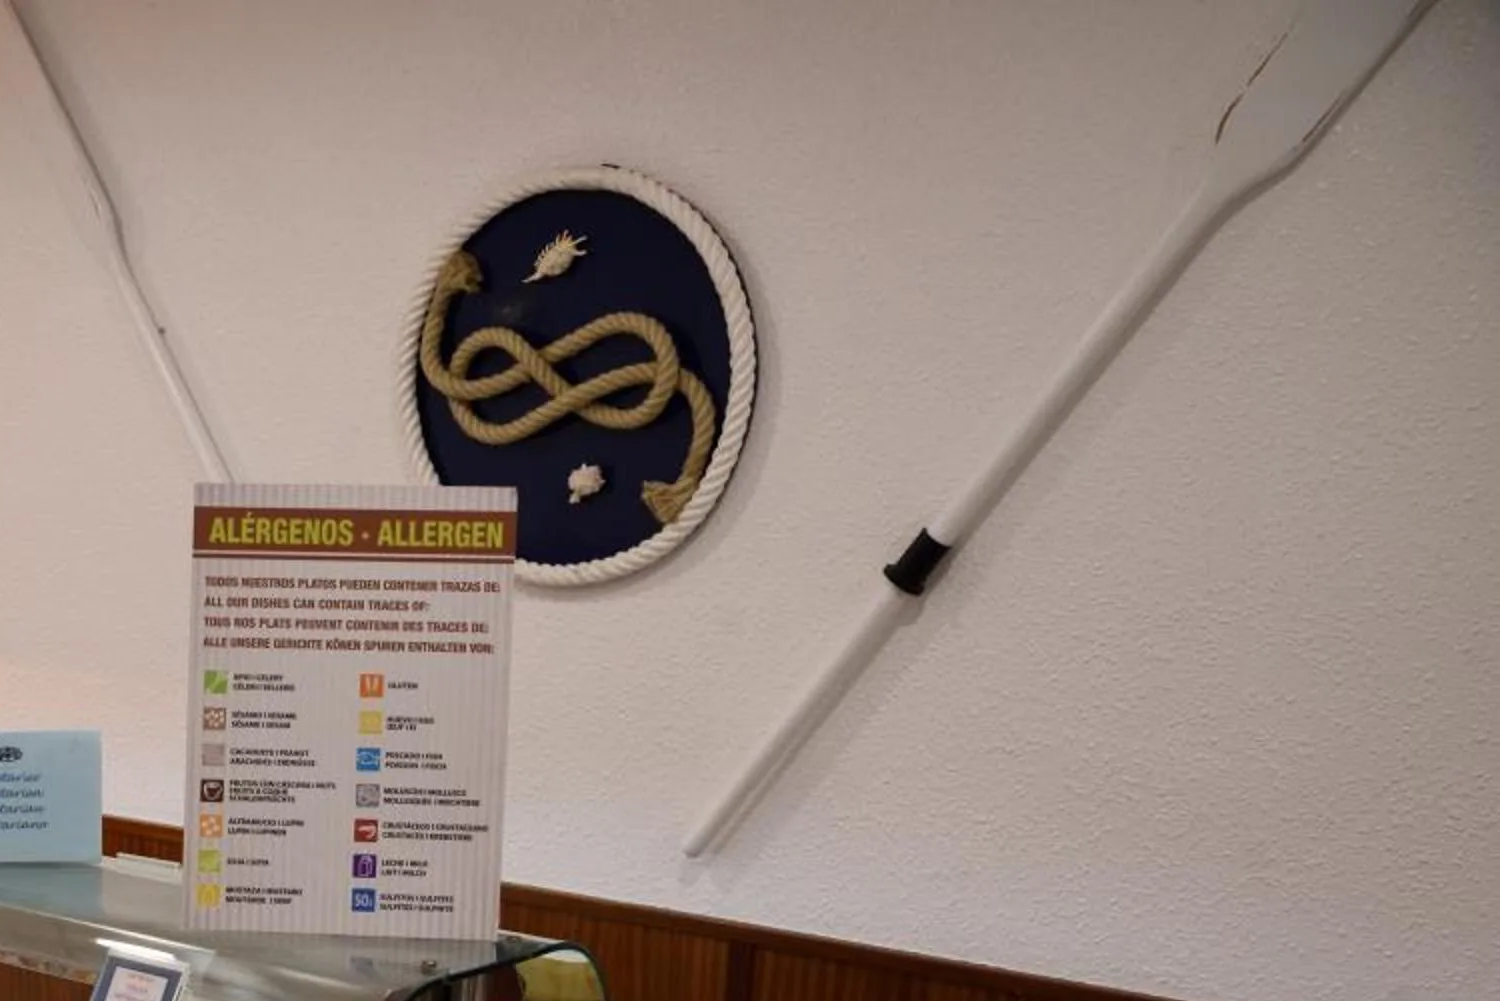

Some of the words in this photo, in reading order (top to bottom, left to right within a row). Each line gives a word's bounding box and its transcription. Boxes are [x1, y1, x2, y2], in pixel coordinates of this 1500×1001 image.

[208, 511, 354, 547] ALÉRGENOS
[377, 520, 504, 548] ALLERGEN
[204, 576, 239, 588] TODOS
[241, 577, 295, 589] NUESTROS
[297, 578, 337, 590] PLATOS
[339, 579, 381, 590] PUEDEN
[441, 581, 481, 593] TRAZAS
[203, 596, 222, 607] ALL
[226, 597, 249, 608] OUR
[251, 597, 290, 608] DISHES
[293, 599, 315, 609] CAN
[318, 599, 365, 610] CONTAIN
[369, 600, 409, 611] TRACES
[204, 616, 231, 628] TOUS
[233, 617, 257, 629] NOS
[259, 618, 292, 629] PLATS
[295, 619, 342, 630] PEUVENT
[345, 620, 399, 631] CONTENIR
[402, 621, 423, 632] DES
[426, 622, 469, 633] TRACES
[203, 636, 227, 648] ALLE
[229, 637, 271, 649] UNSERE
[363, 640, 405, 652] SPUREN
[408, 641, 468, 653] ENTHALTEN
